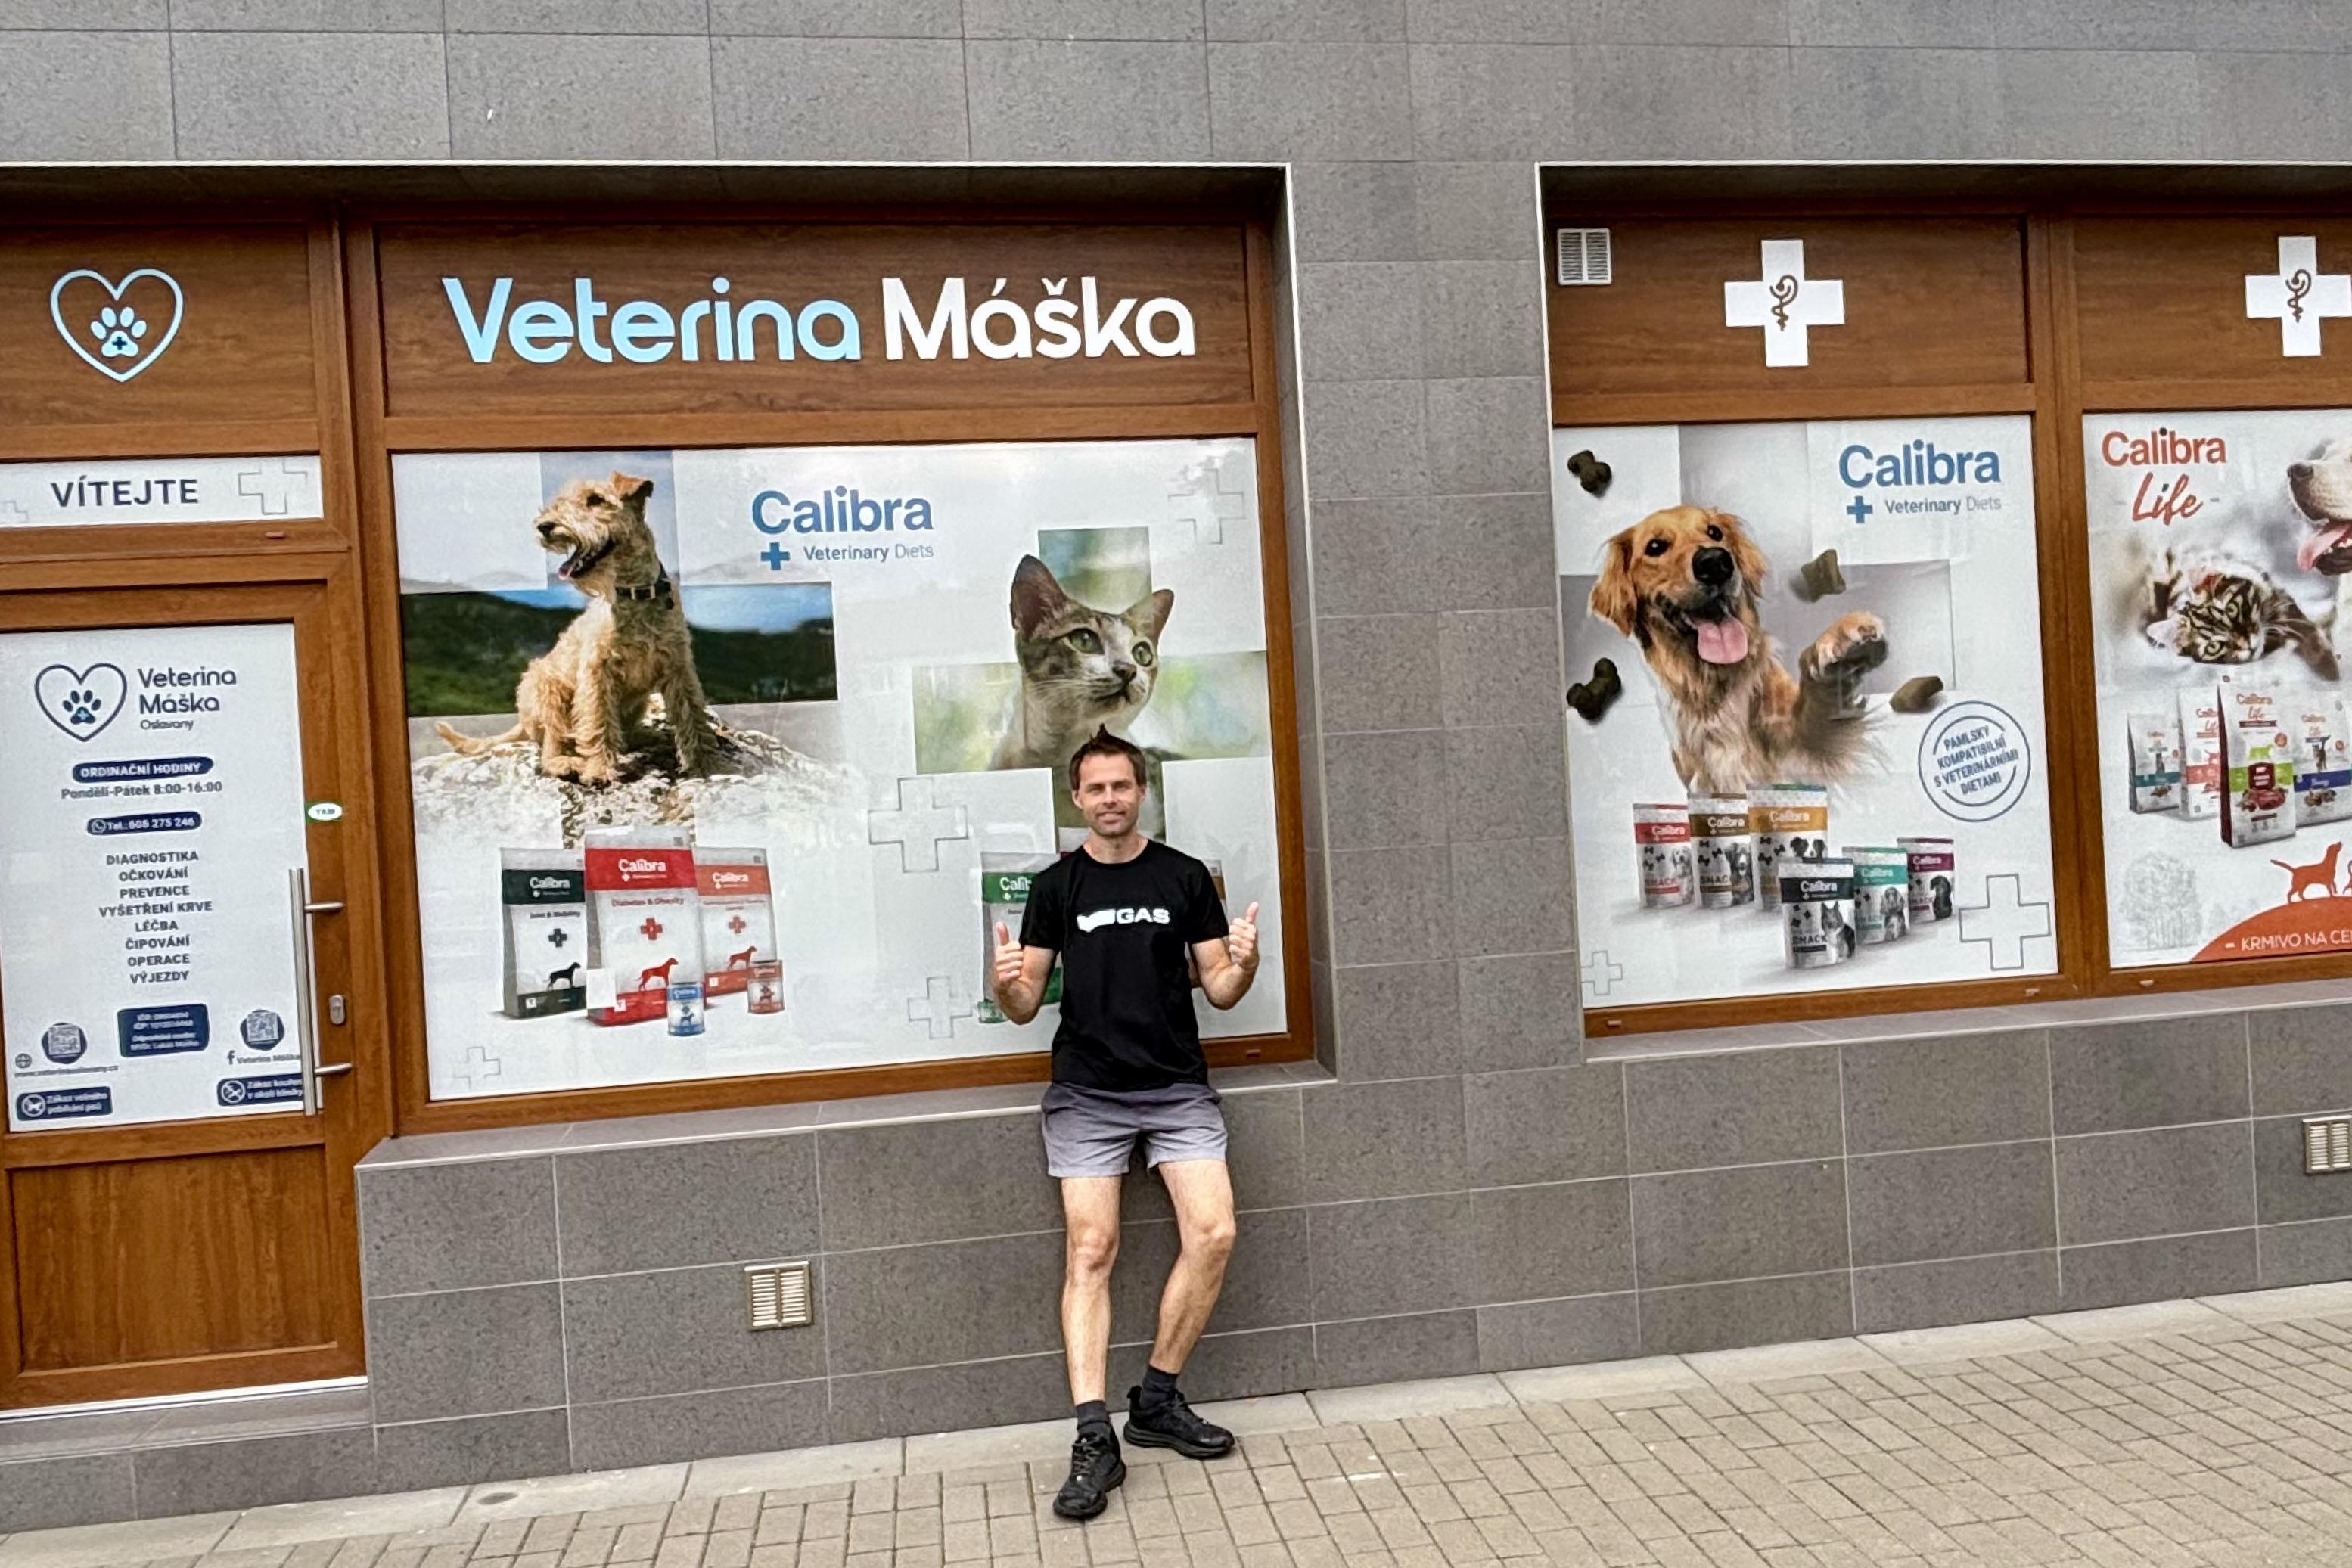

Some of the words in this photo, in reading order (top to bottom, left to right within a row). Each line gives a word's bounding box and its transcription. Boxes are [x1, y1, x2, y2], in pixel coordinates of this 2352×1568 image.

[442, 276, 861, 365] Veterina
[882, 275, 1197, 362] Máška
[2102, 427, 2226, 466] Calibra
[1839, 439, 2002, 488] Calibra
[51, 475, 199, 508] VÍTEJTE
[2132, 473, 2202, 525] Life
[751, 484, 935, 537] Calibra
[1884, 497, 1962, 516] Veterinary
[1966, 495, 2002, 511] Diets
[803, 543, 890, 564] Veterinary
[895, 542, 935, 560] Diets
[138, 666, 237, 688] Veterina
[139, 693, 220, 714] Máška
[141, 718, 194, 731] Oslavany
[1944, 725, 1990, 750] PAMLSKY
[1937, 734, 2006, 769] KOMPATIBILNÍ
[80, 763, 151, 778] ORDINAČNÍ
[154, 762, 201, 775] HODINY
[1934, 775, 1942, 787] S
[1961, 771, 2002, 795] DIETAMI
[151, 818, 172, 828] 275
[106, 851, 199, 865] DIAGNOSTIKA
[618, 859, 666, 872] Calibra
[119, 866, 188, 882] OČKOVÁNÍ
[120, 885, 190, 899] PREVENCE
[98, 902, 174, 918] VYŠETŘENÍ
[177, 901, 213, 914] KRVE
[1116, 908, 1170, 924] GAS
[135, 919, 179, 933] LÉČBA
[125, 935, 190, 950] ČIPOVÁNÍ
[2241, 933, 2302, 951] KRMIVO
[2304, 931, 2328, 945] NA
[127, 954, 190, 967] OPERACE
[130, 969, 189, 984] VÝJEZDY
